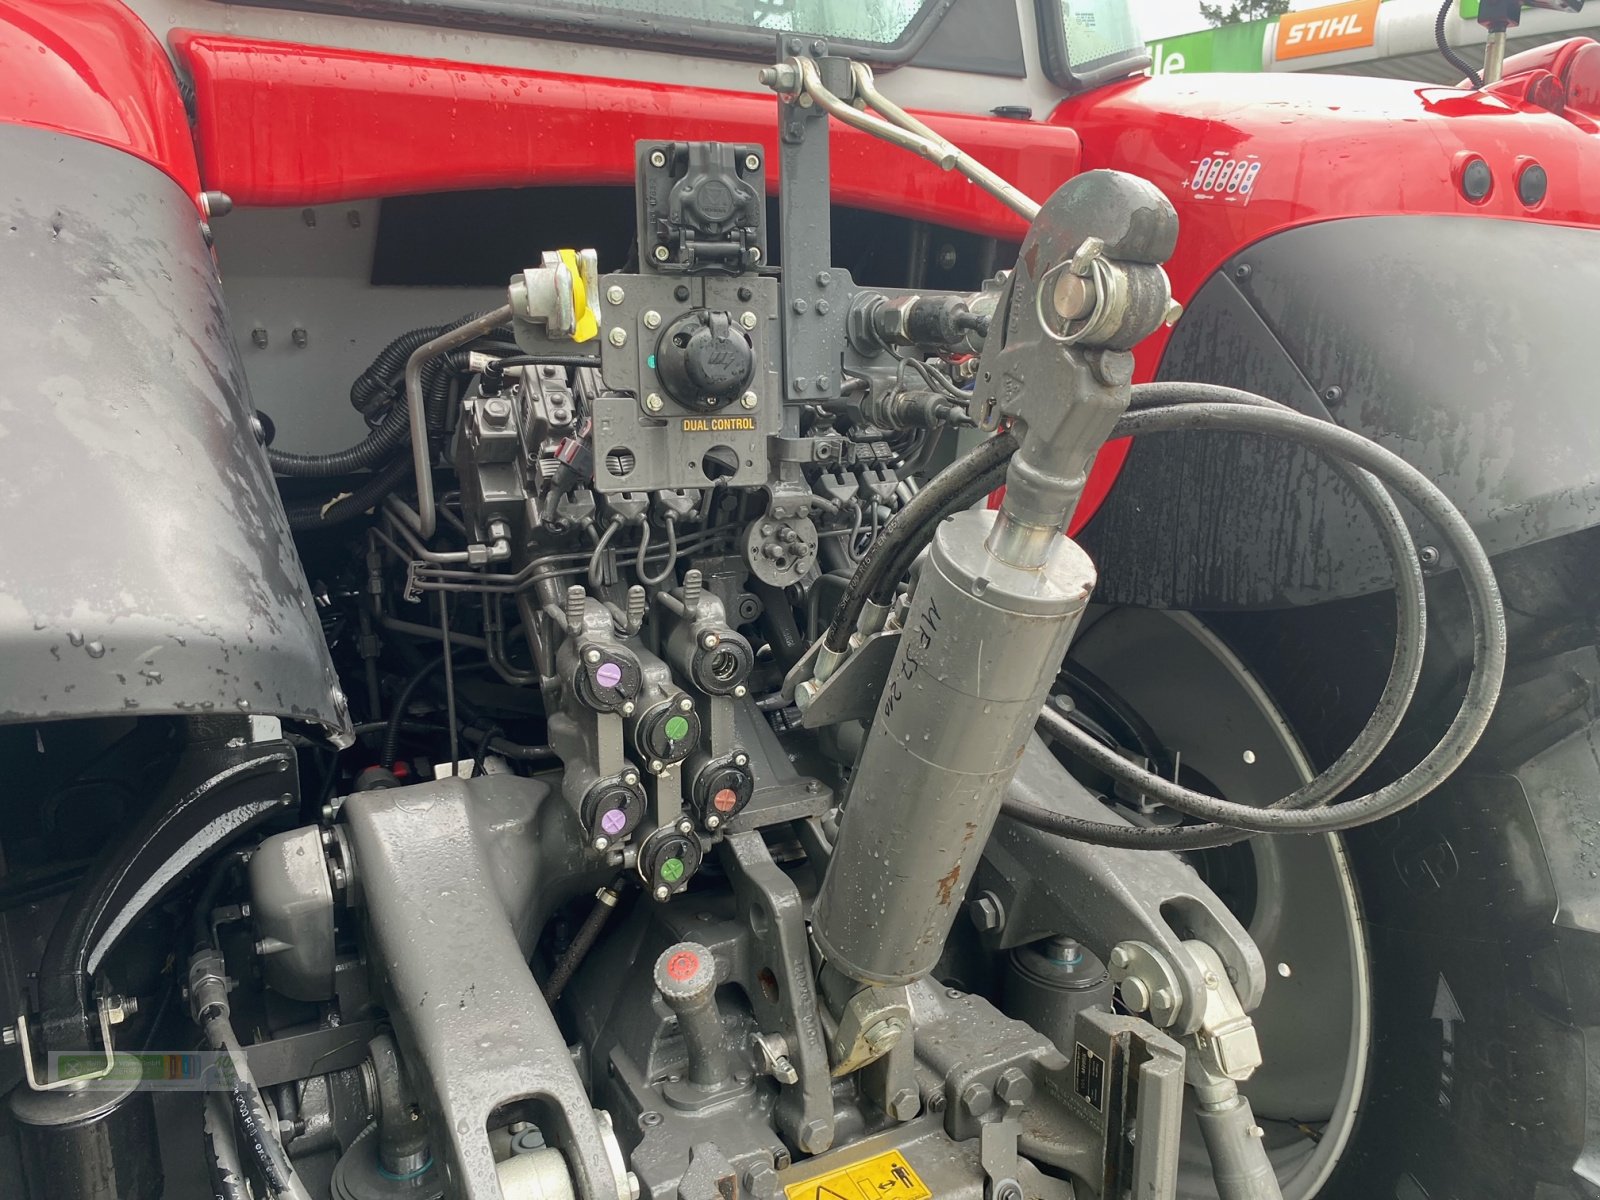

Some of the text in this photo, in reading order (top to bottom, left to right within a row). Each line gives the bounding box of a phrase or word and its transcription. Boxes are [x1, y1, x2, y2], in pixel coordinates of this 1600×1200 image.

[1286, 14, 1362, 44] STIHL
[684, 418, 754, 430] DUAL CONTROL
[848, 574, 860, 590] 100
[858, 556, 871, 573] R16
[876, 533, 888, 546] EN
